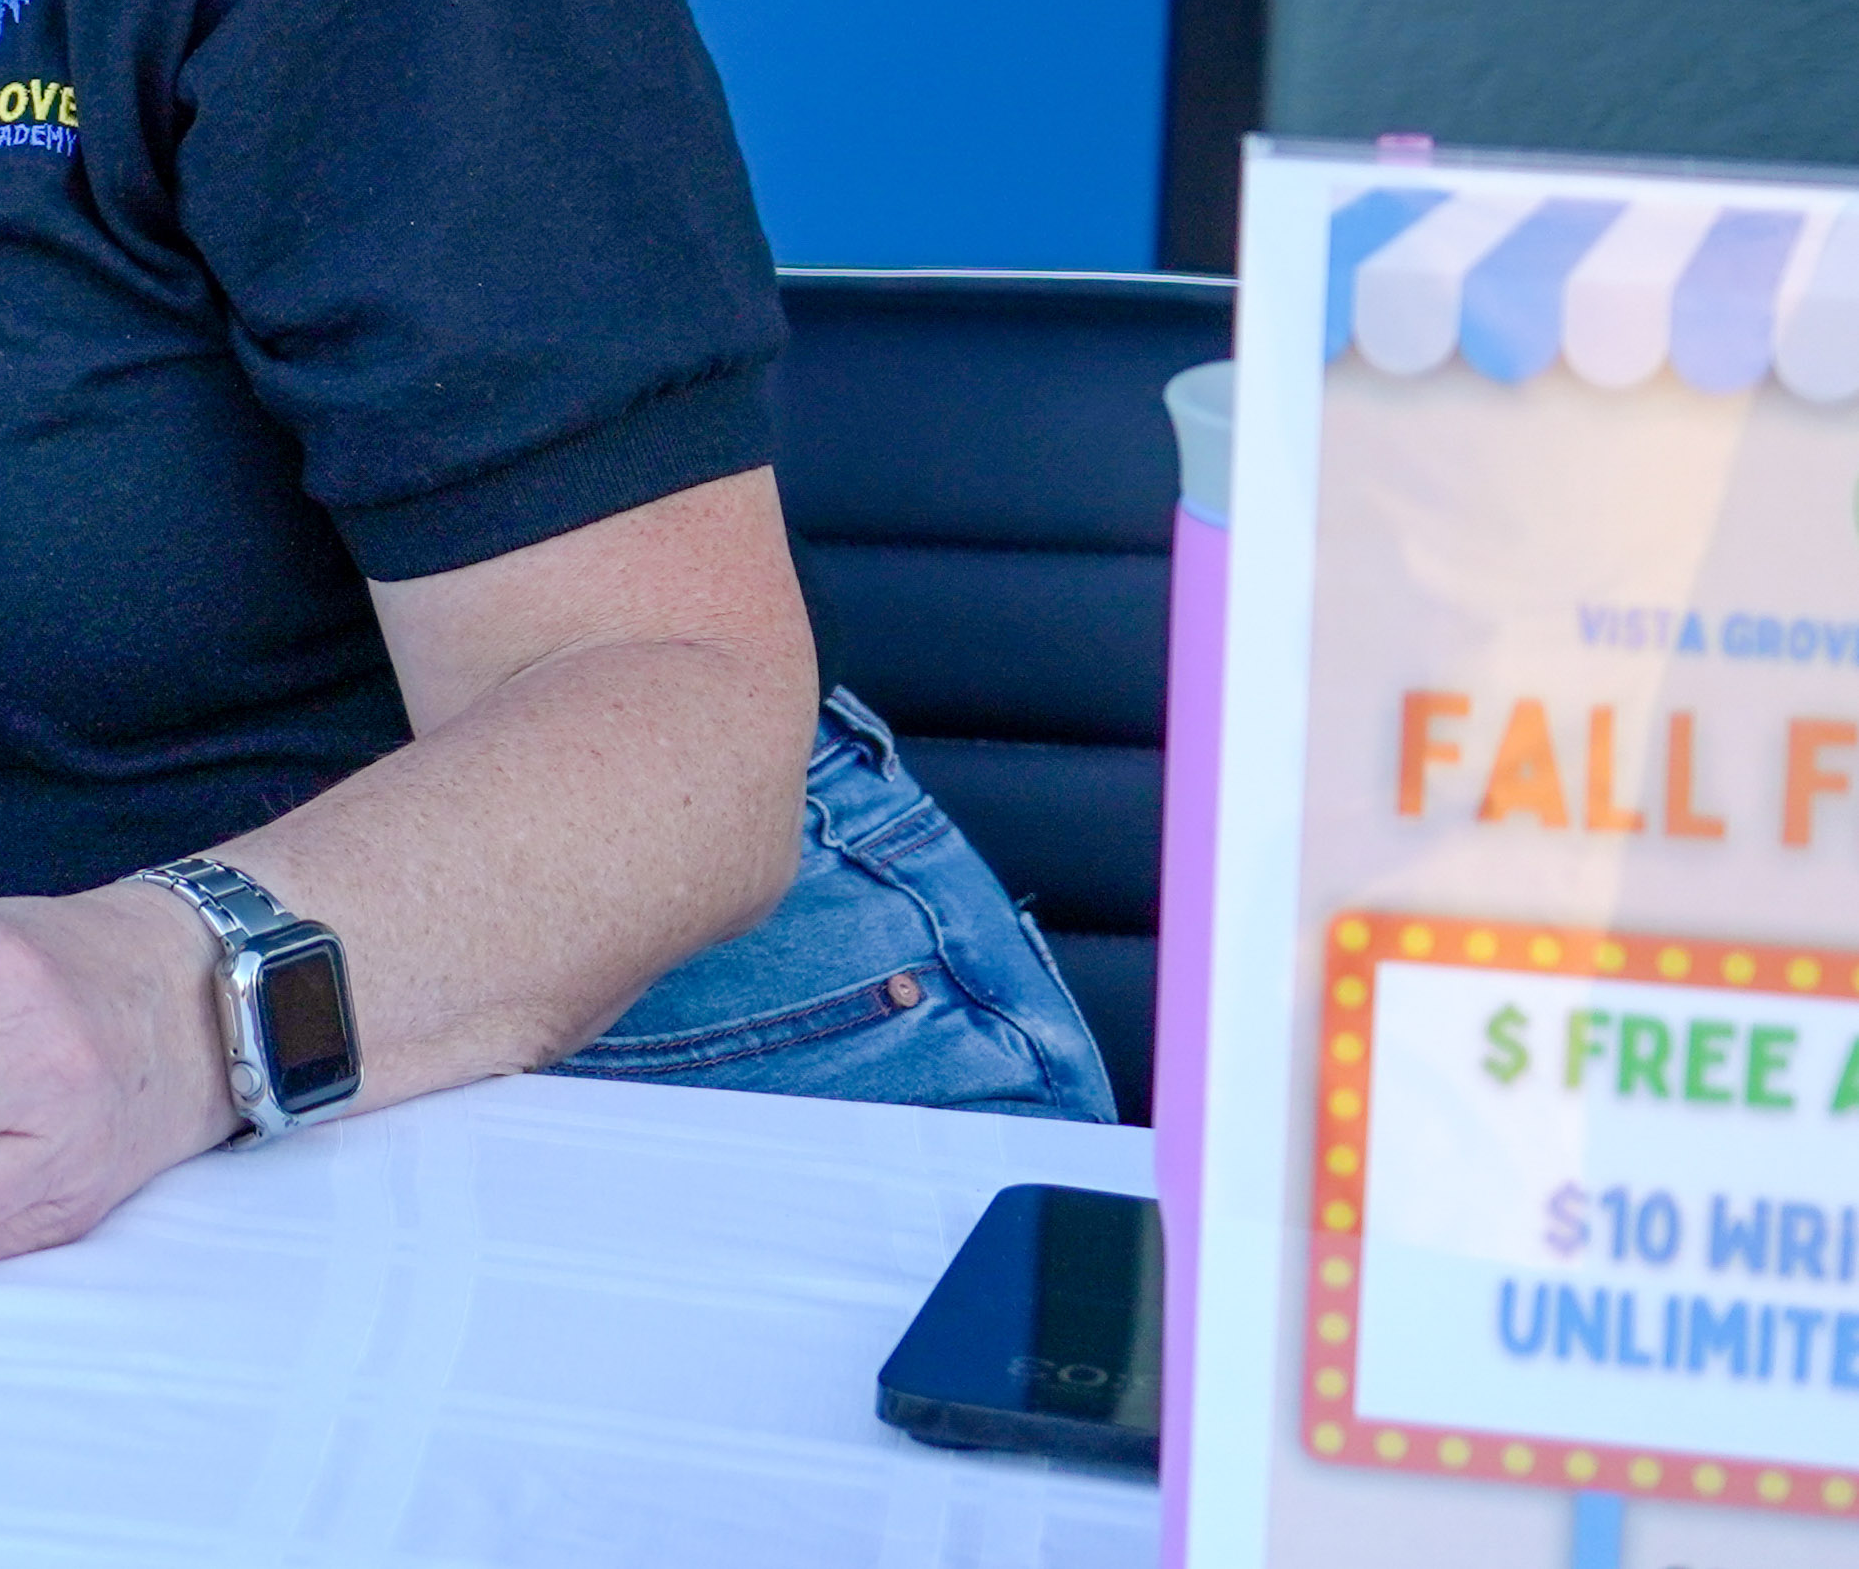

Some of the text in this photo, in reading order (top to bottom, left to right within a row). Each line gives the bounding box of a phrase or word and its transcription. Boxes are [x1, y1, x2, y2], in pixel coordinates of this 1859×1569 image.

[1578, 605, 1859, 666] VISTA GROV
[1397, 690, 1727, 841] FALL
[1481, 1003, 1531, 1086] $
[1563, 1009, 1799, 1109] FREE
[1542, 1180, 1681, 1267] $10
